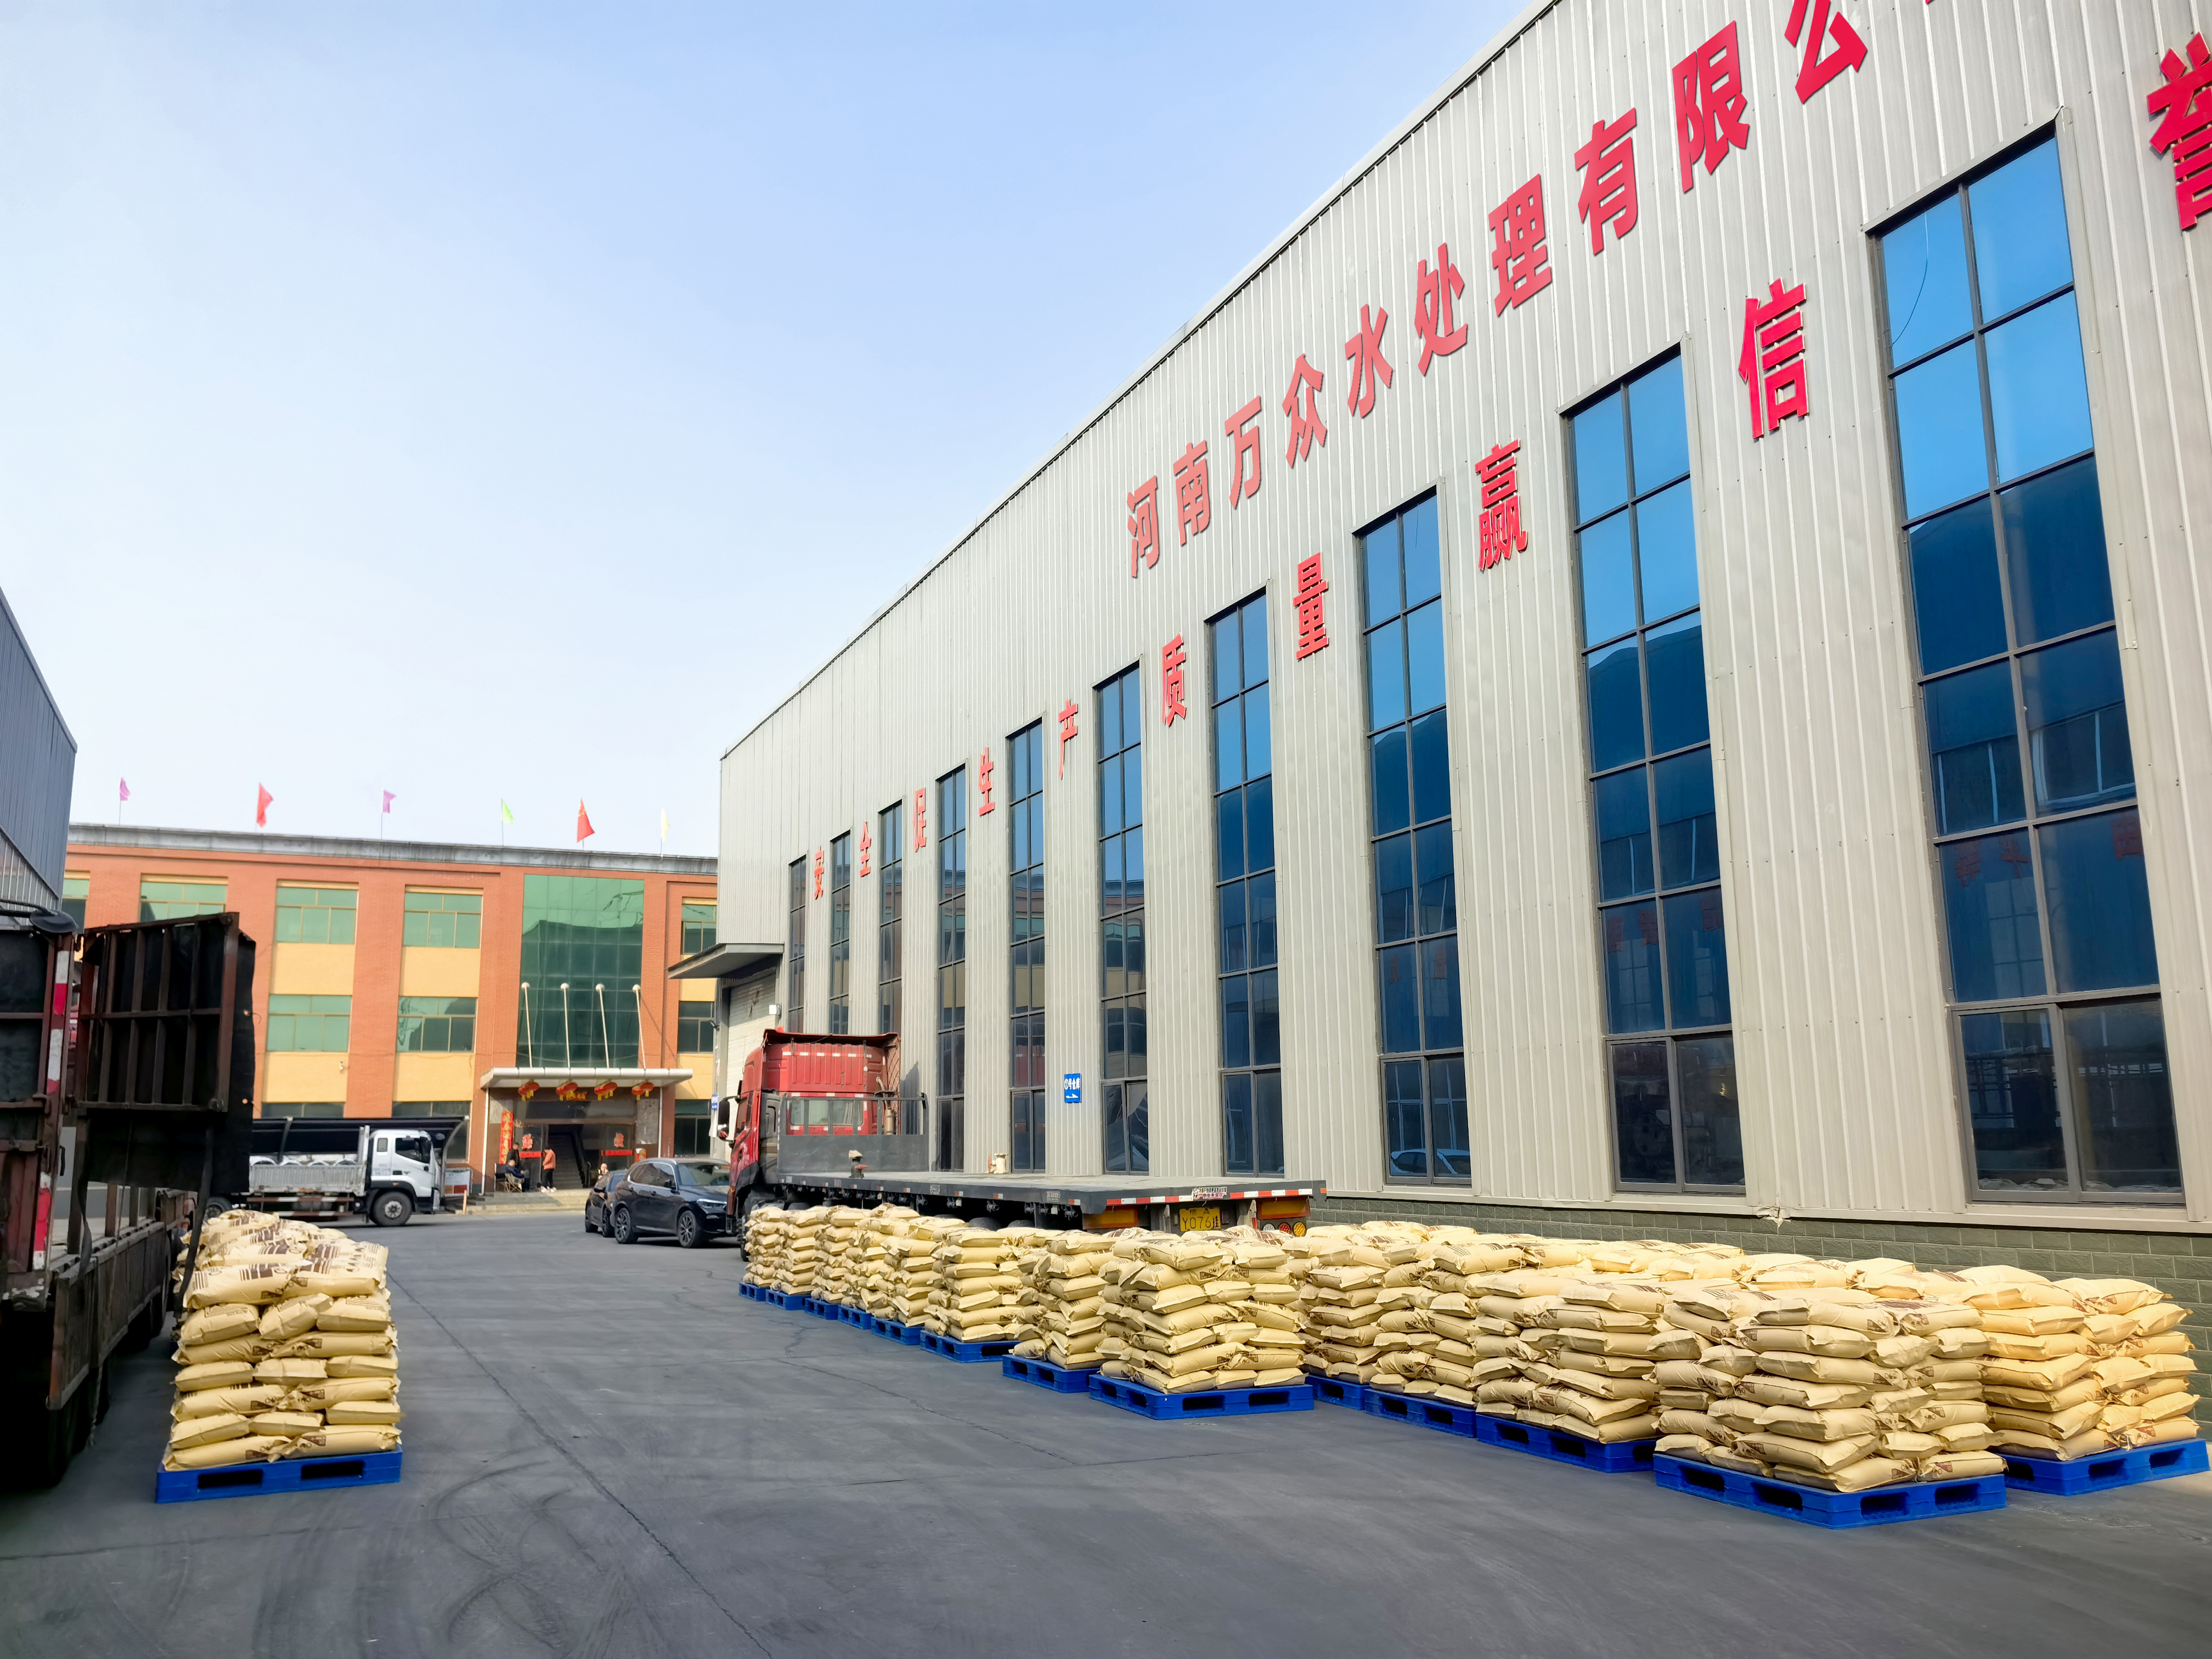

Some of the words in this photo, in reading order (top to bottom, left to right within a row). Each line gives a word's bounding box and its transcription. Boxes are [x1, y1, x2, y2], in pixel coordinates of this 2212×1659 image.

[1127, 0, 1932, 577] 河南万众水处理有限公
[1182, 1216, 1219, 1230] Y076挂
